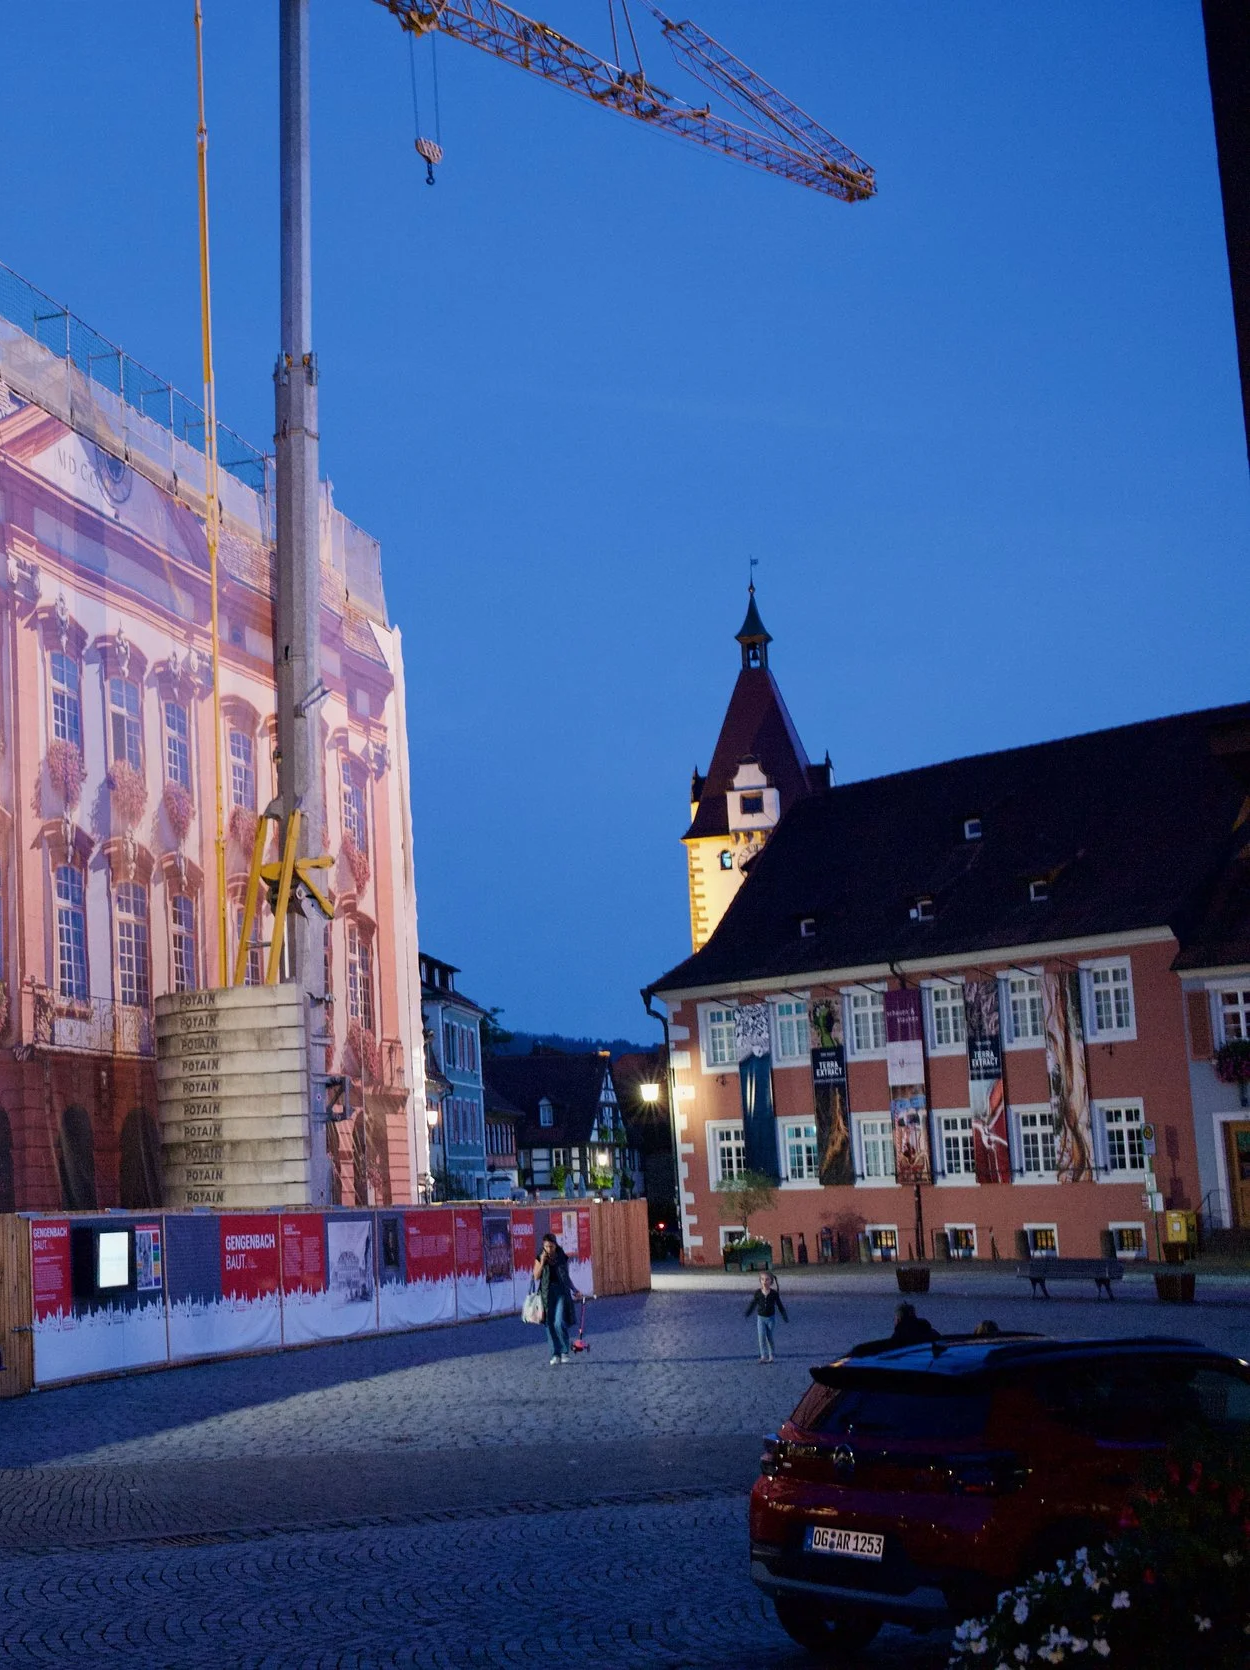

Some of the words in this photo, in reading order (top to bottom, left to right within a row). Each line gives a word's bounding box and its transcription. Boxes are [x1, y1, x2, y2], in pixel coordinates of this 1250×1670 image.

[181, 1058, 220, 1072] POTAIN
[819, 1060, 839, 1069] TERRA
[182, 1080, 220, 1094] POTAIN
[183, 1102, 221, 1116] POTAIN
[184, 1124, 222, 1138] POTAIN
[185, 1169, 223, 1182] POTAIN
[186, 1190, 225, 1203] POTAIN
[225, 1233, 276, 1251] GENGENBACH
[225, 1254, 248, 1271] BAUT.
[813, 1529, 829, 1547] OG
[836, 1532, 851, 1550] AR
[852, 1534, 883, 1555] 1253
